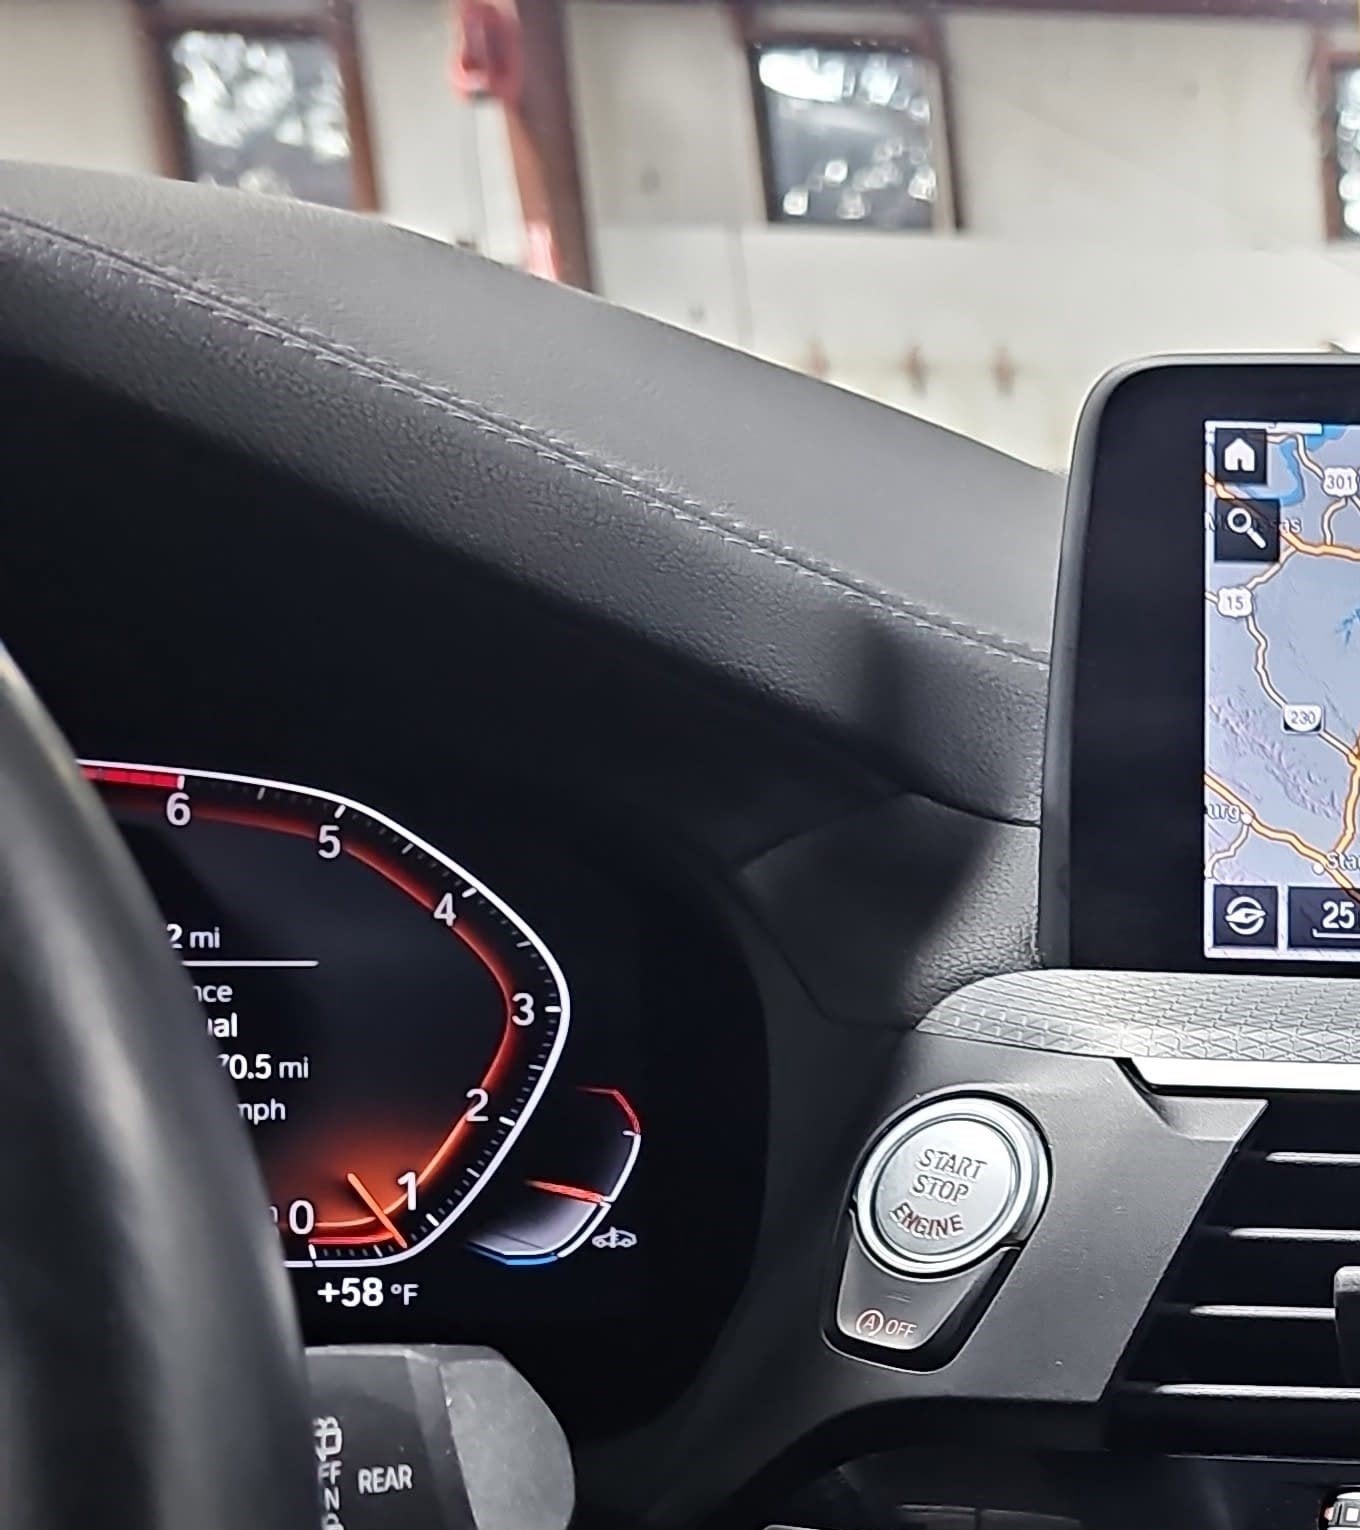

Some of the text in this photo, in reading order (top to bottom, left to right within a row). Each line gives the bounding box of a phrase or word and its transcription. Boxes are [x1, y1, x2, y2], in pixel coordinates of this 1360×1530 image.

[1326, 474, 1353, 491] 301
[1227, 595, 1244, 611] 15
[1290, 710, 1316, 725] 230
[166, 792, 191, 827] 6
[318, 825, 342, 858] 5
[433, 893, 457, 926] 4
[1321, 901, 1355, 929] 25
[189, 926, 221, 949] mi
[512, 993, 535, 1027] 3
[279, 1056, 310, 1079] mi
[466, 1088, 489, 1122] 2
[919, 1148, 988, 1180] START
[397, 1171, 417, 1211] 1
[912, 1174, 970, 1203] STOP
[289, 1199, 315, 1235] 0
[891, 1201, 965, 1239] ENGINE
[317, 1276, 419, 1308] +58 °F
[884, 1318, 918, 1338] OFF
[357, 1463, 413, 1495] REAR
